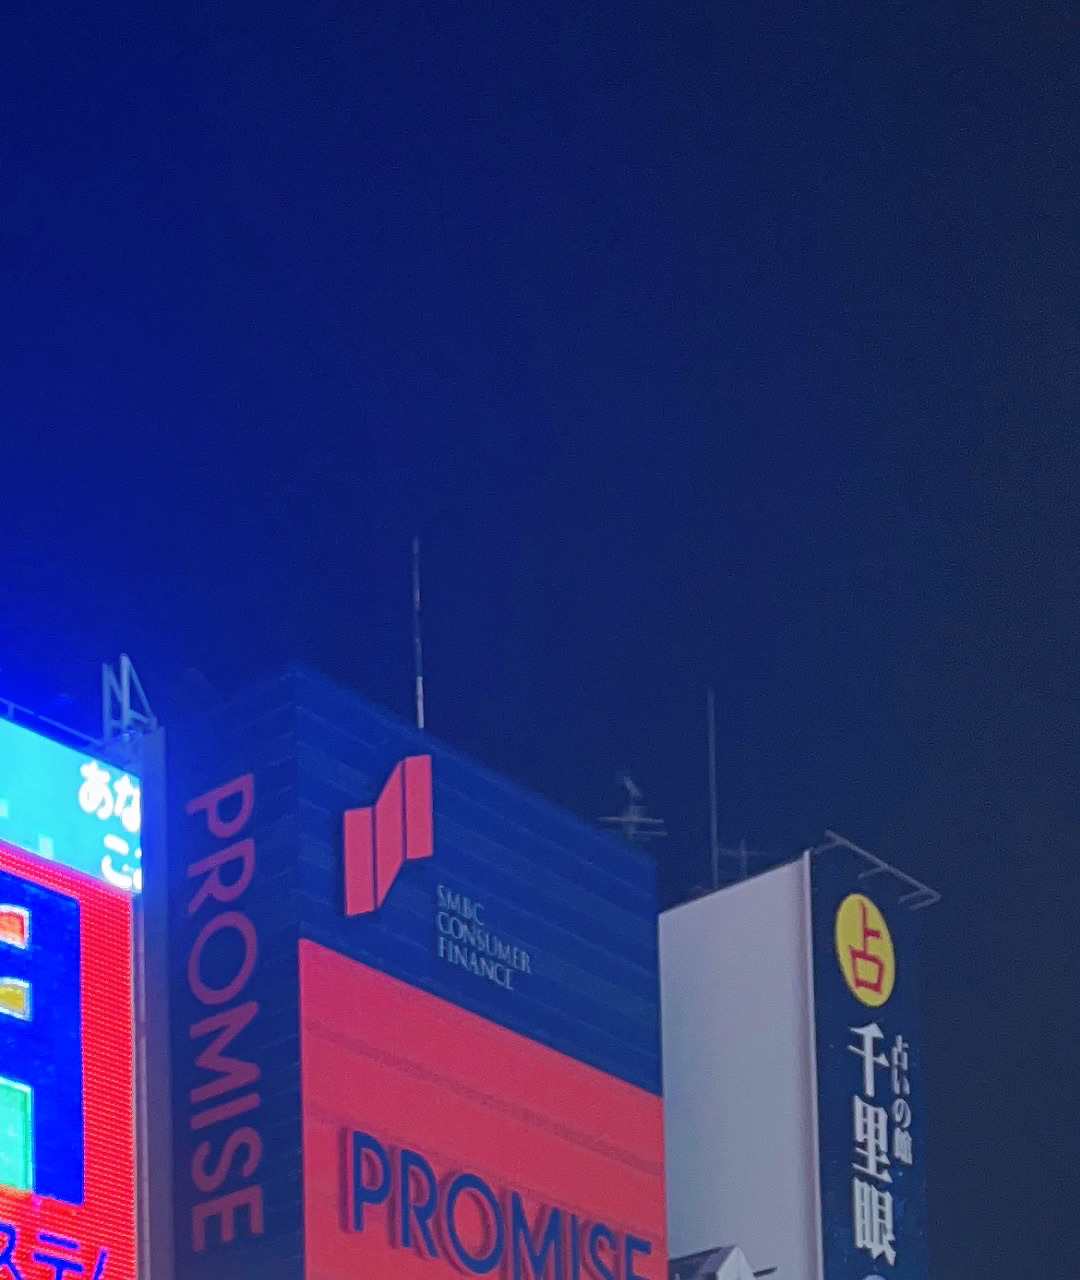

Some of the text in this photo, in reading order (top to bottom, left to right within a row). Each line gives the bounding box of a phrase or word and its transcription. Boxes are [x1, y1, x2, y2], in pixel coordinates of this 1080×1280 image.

[437, 885, 484, 926] SMBC
[437, 911, 532, 975] CONSUMER
[438, 936, 514, 990] FINANCE
[850, 898, 887, 995] 占
[187, 773, 264, 1252] PROMISE
[847, 1022, 897, 1267] 千里眼
